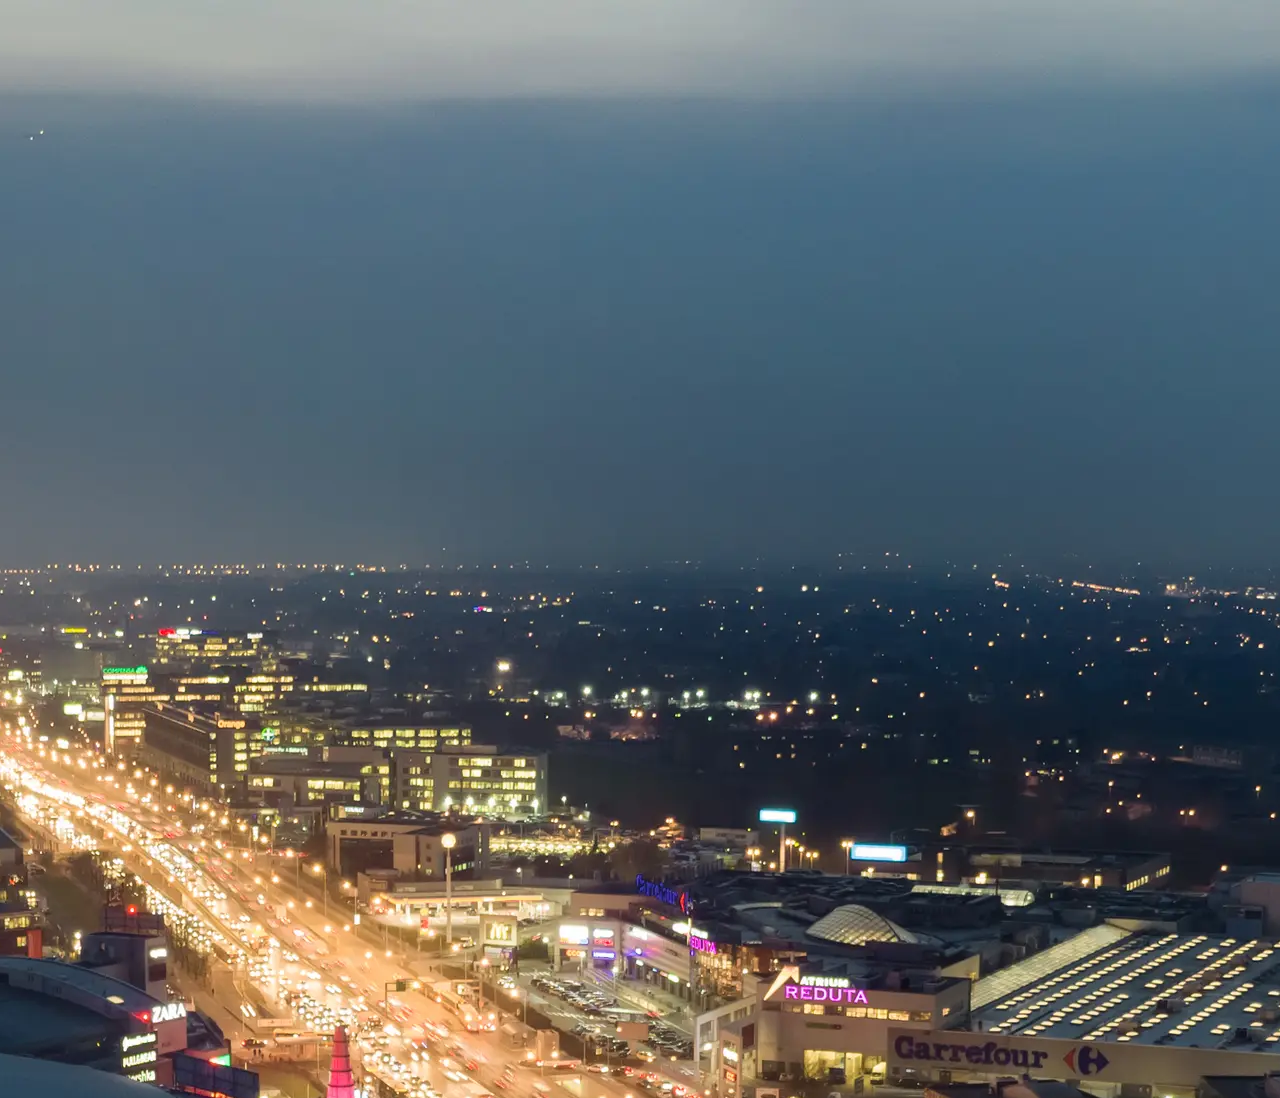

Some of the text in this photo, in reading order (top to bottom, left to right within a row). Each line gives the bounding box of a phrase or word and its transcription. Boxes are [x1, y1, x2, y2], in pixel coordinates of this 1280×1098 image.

[690, 936, 717, 955] EDUTA
[800, 976, 849, 988] ATRIUM
[785, 985, 868, 1004] REDUTA
[152, 1003, 186, 1023] ZARA
[894, 1035, 1048, 1068] Carrefour
